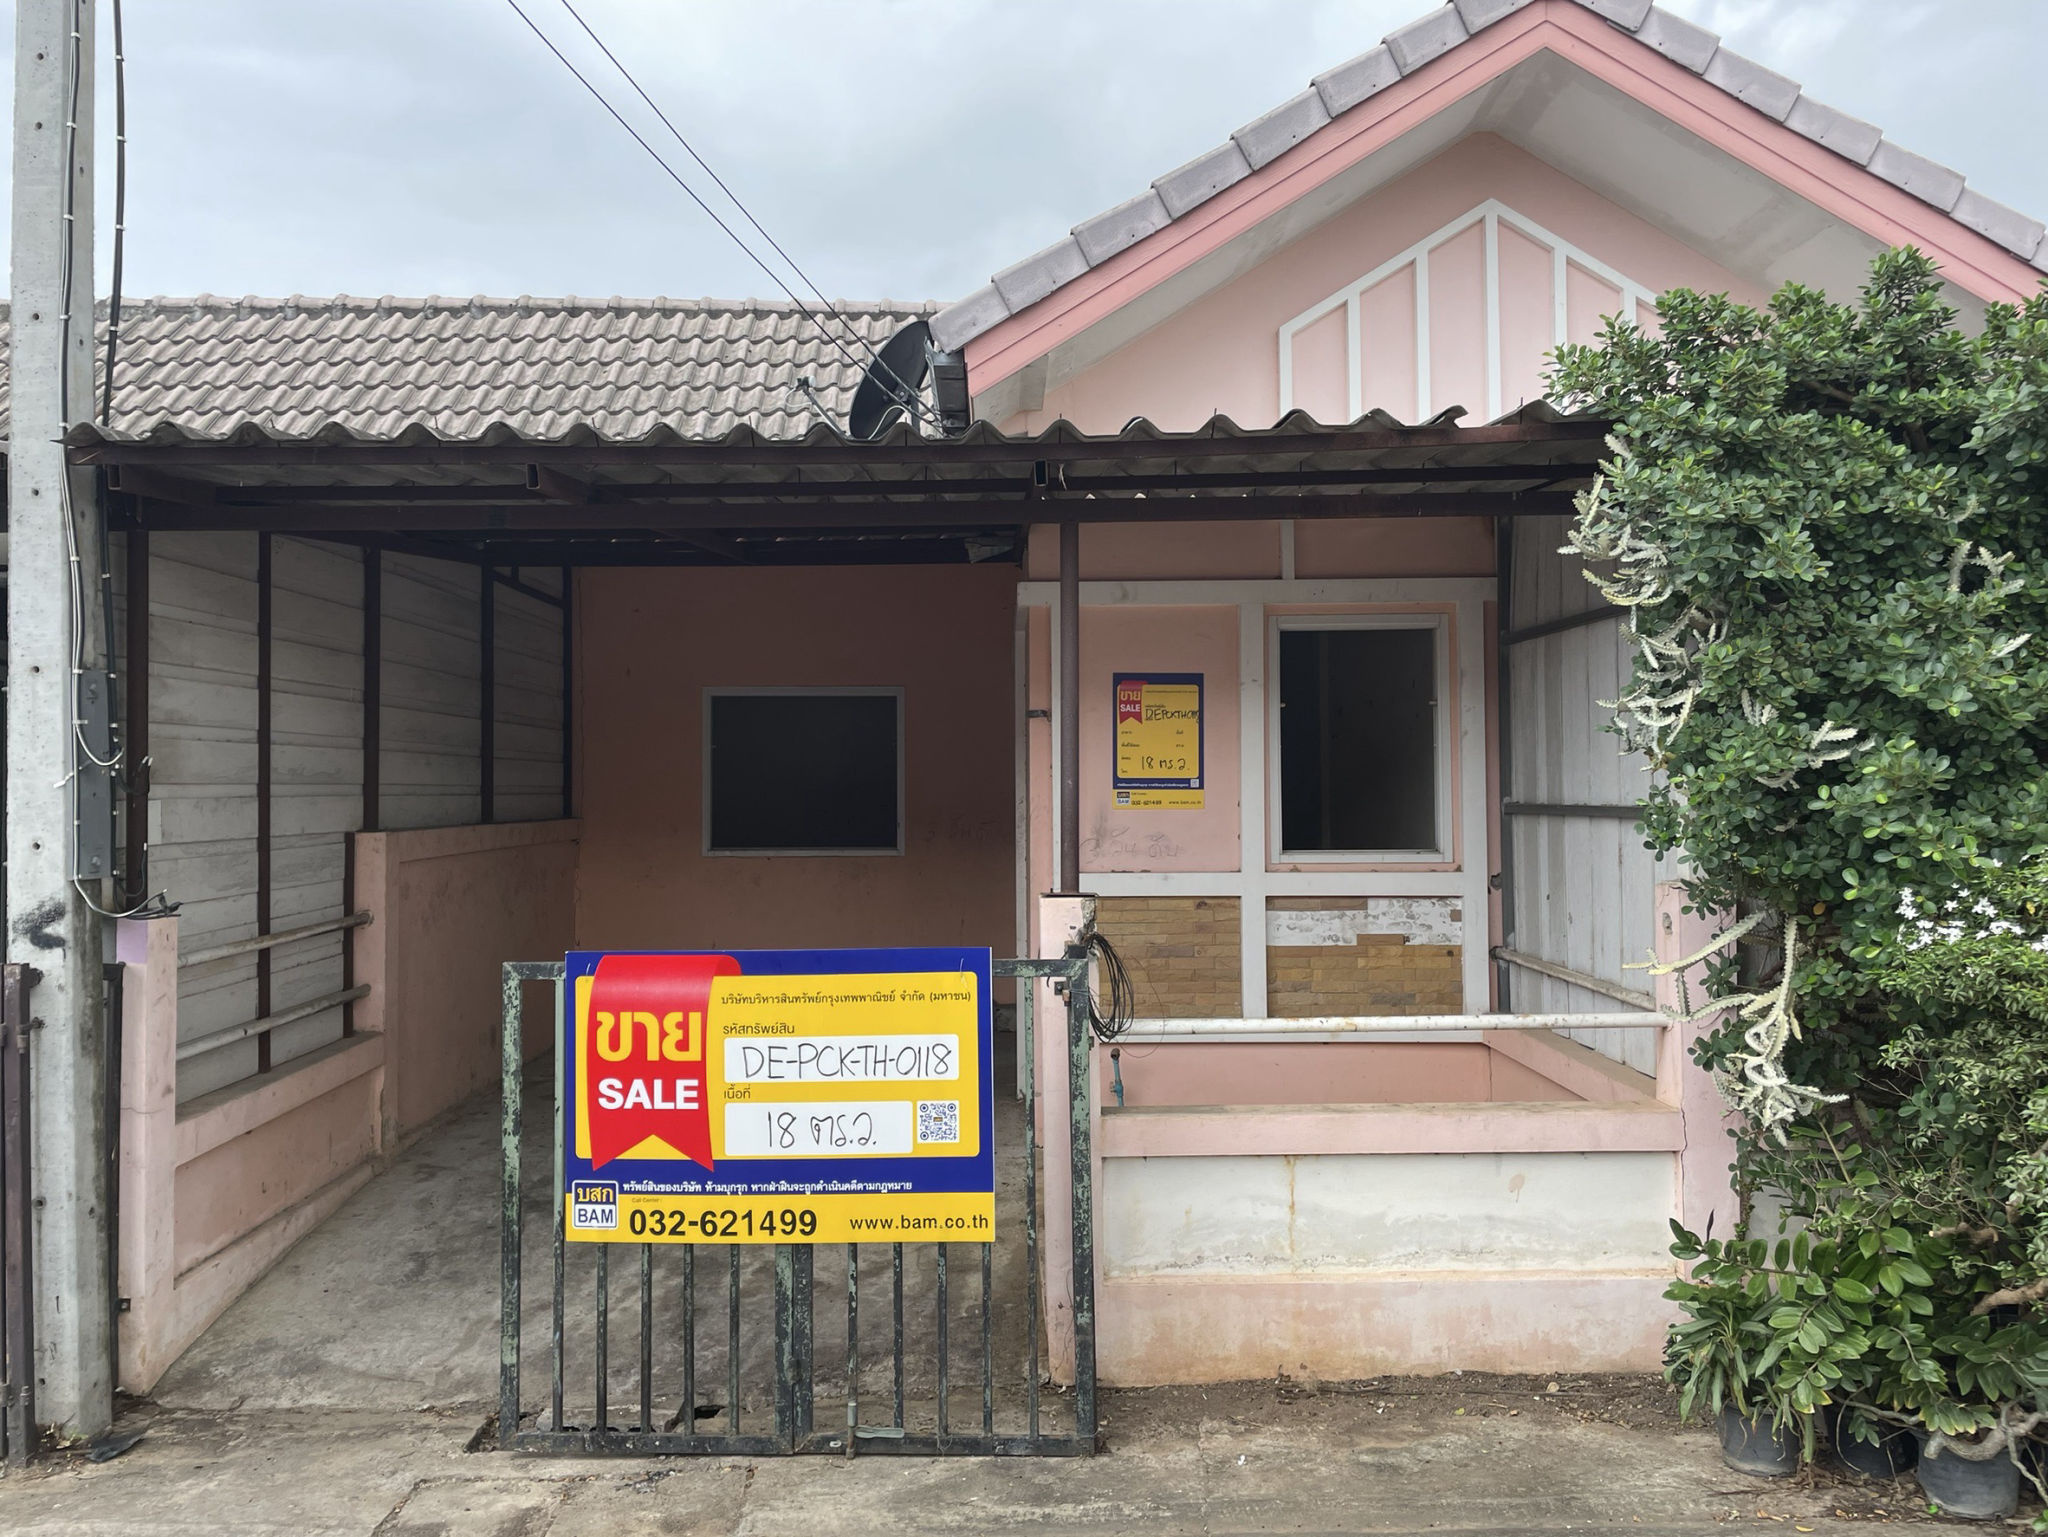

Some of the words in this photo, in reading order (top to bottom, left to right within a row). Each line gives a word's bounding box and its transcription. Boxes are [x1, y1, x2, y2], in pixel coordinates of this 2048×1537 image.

[1120, 704, 1140, 712] SALE
[1141, 756, 1154, 770] 18
[721, 990, 896, 1008] บริษัทบริหารสินทรัพย์กรุงเทพพาณิชย์
[901, 991, 926, 1001] จำกัด
[929, 991, 971, 1003] (มหาชน)
[723, 1021, 795, 1035] รหัสทรัพย์สิน
[596, 1011, 702, 1062] ขาย
[598, 1078, 699, 1110] SALE
[723, 1083, 751, 1100] เนื้อที่
[767, 1111, 796, 1148] 18
[577, 1187, 614, 1203] บสก
[623, 1180, 702, 1193] ทรัพย์สินของบริษัท
[705, 1181, 748, 1196] ห้ามบุกรุก
[578, 1208, 613, 1224] BAM
[630, 1209, 817, 1236] 032-621499
[849, 1215, 989, 1230] www.bam.co.th
